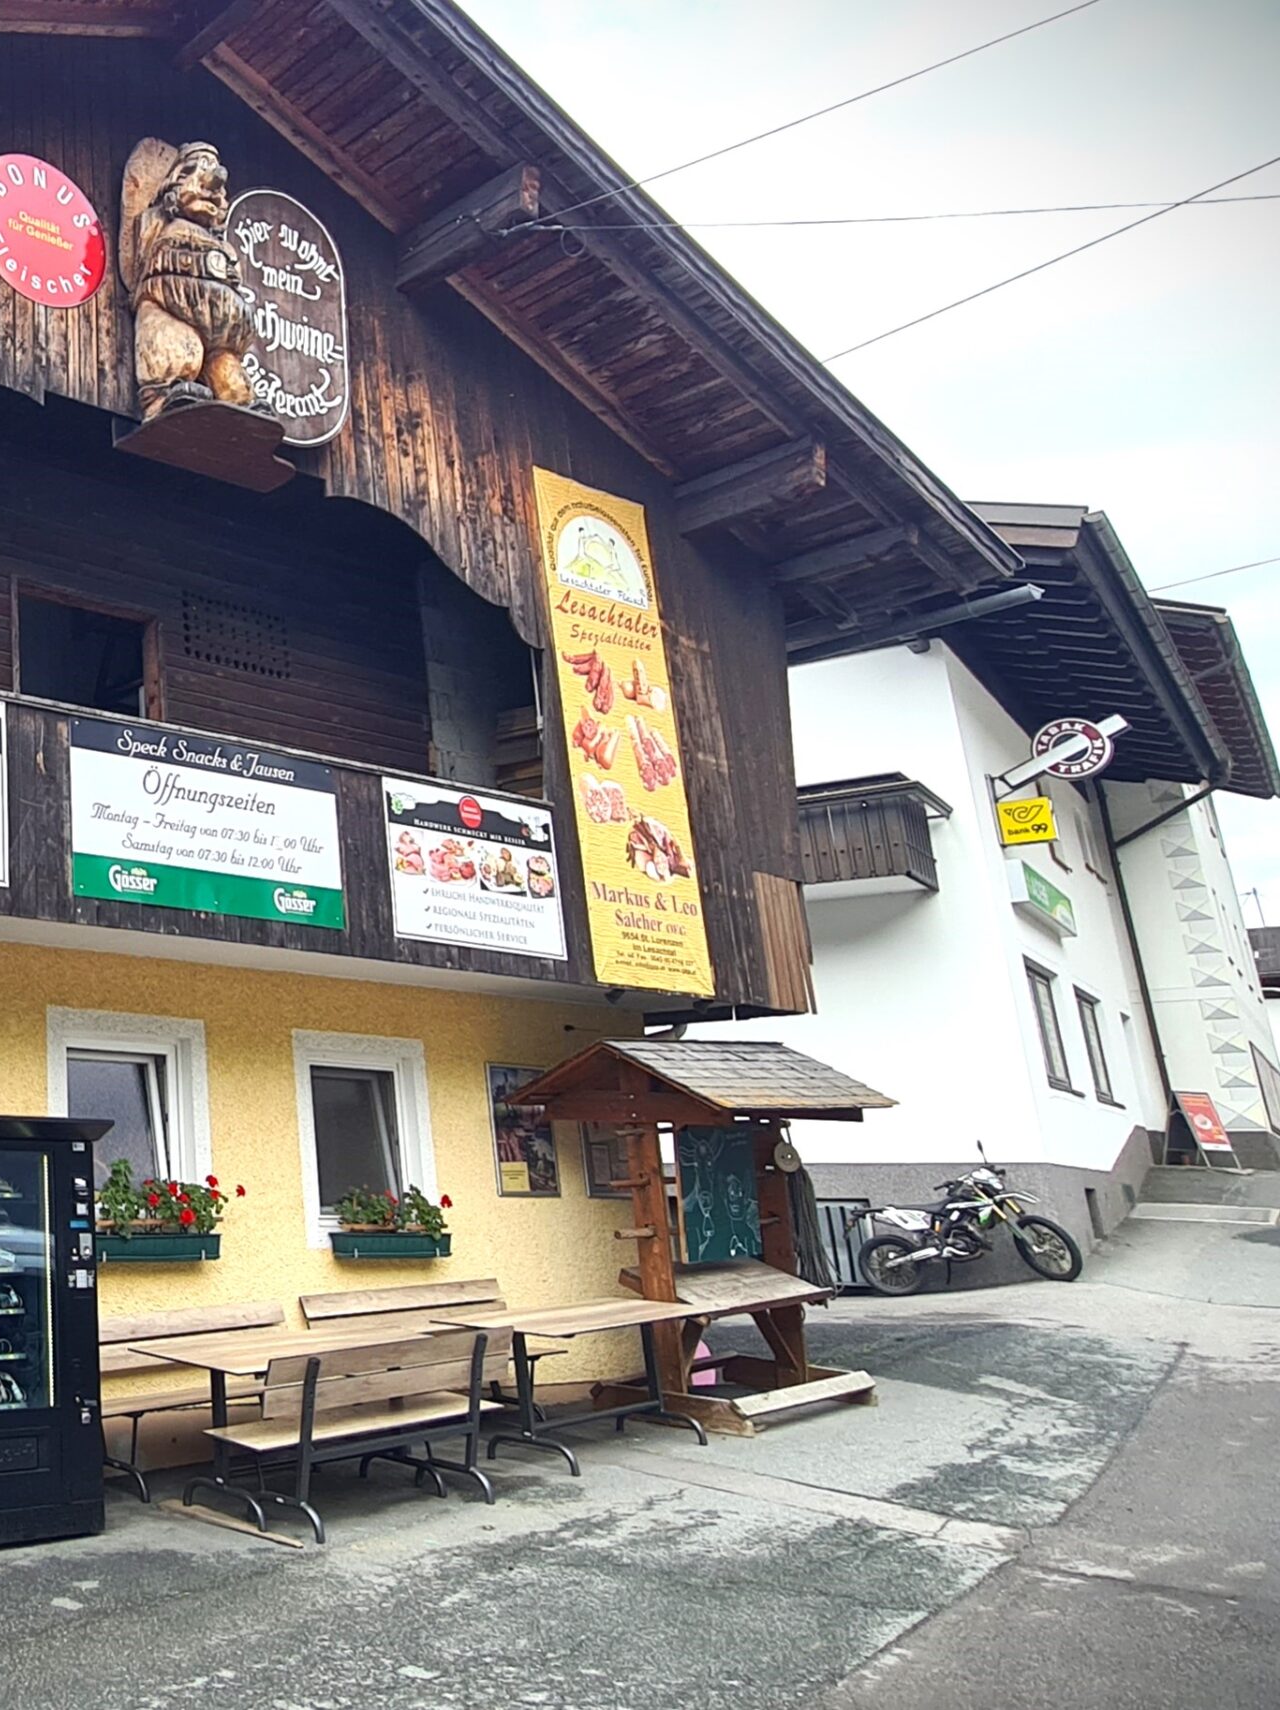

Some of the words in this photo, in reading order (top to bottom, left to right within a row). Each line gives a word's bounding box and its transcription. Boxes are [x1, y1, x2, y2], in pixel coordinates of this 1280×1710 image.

[7, 218, 24, 233] für
[18, 210, 61, 236] Qualität
[555, 590, 659, 638] Lesachtaler
[570, 623, 652, 652] Spezialitäten
[1037, 722, 1087, 752] TABAK
[116, 729, 168, 759] Speck
[172, 740, 228, 768] Snacks
[229, 754, 244, 772] &
[241, 752, 295, 782] Jausen
[1058, 738, 1105, 774] TRAFIK
[141, 764, 277, 816] Öffnungszeiten
[90, 801, 140, 830] Montag
[152, 811, 198, 839] Freitag
[199, 826, 219, 838] von
[253, 828, 268, 845] bis
[300, 836, 325, 853] Uhr
[121, 831, 174, 860] Samstag
[176, 848, 195, 859] von
[230, 848, 245, 865] bis
[277, 855, 303, 874] Uhr
[108, 864, 159, 894] Gösser
[273, 887, 317, 915] Gösser
[591, 880, 651, 909] Markus
[654, 892, 668, 912] &
[671, 895, 698, 917] Leo
[614, 908, 663, 933] Salcher
